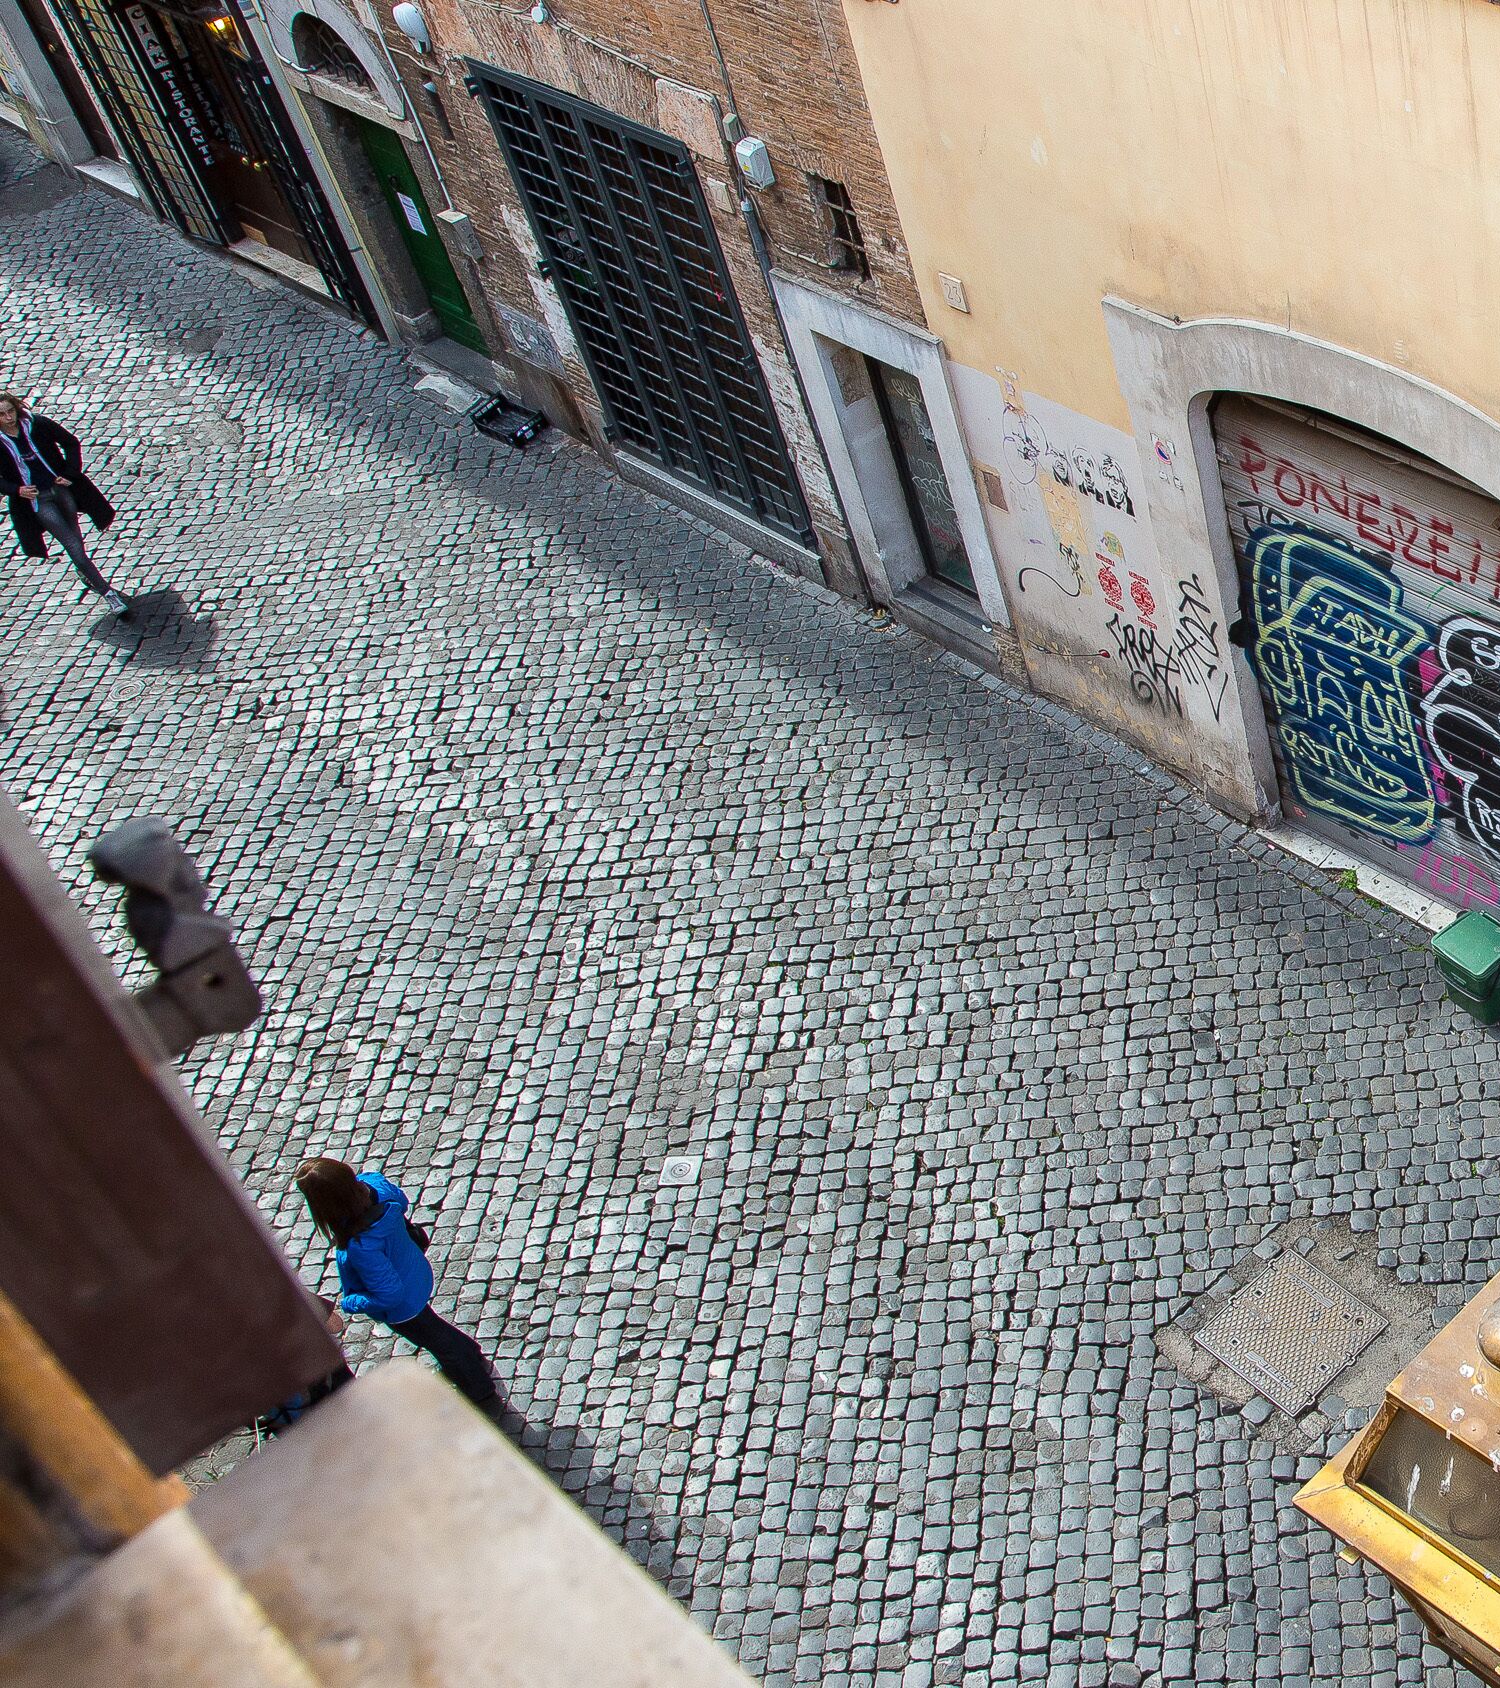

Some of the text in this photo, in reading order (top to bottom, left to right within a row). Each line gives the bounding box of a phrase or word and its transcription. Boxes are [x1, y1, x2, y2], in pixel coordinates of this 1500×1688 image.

[131, 9, 167, 63] CIAK
[160, 70, 215, 166] RISTORANTE
[944, 283, 962, 304] 23
